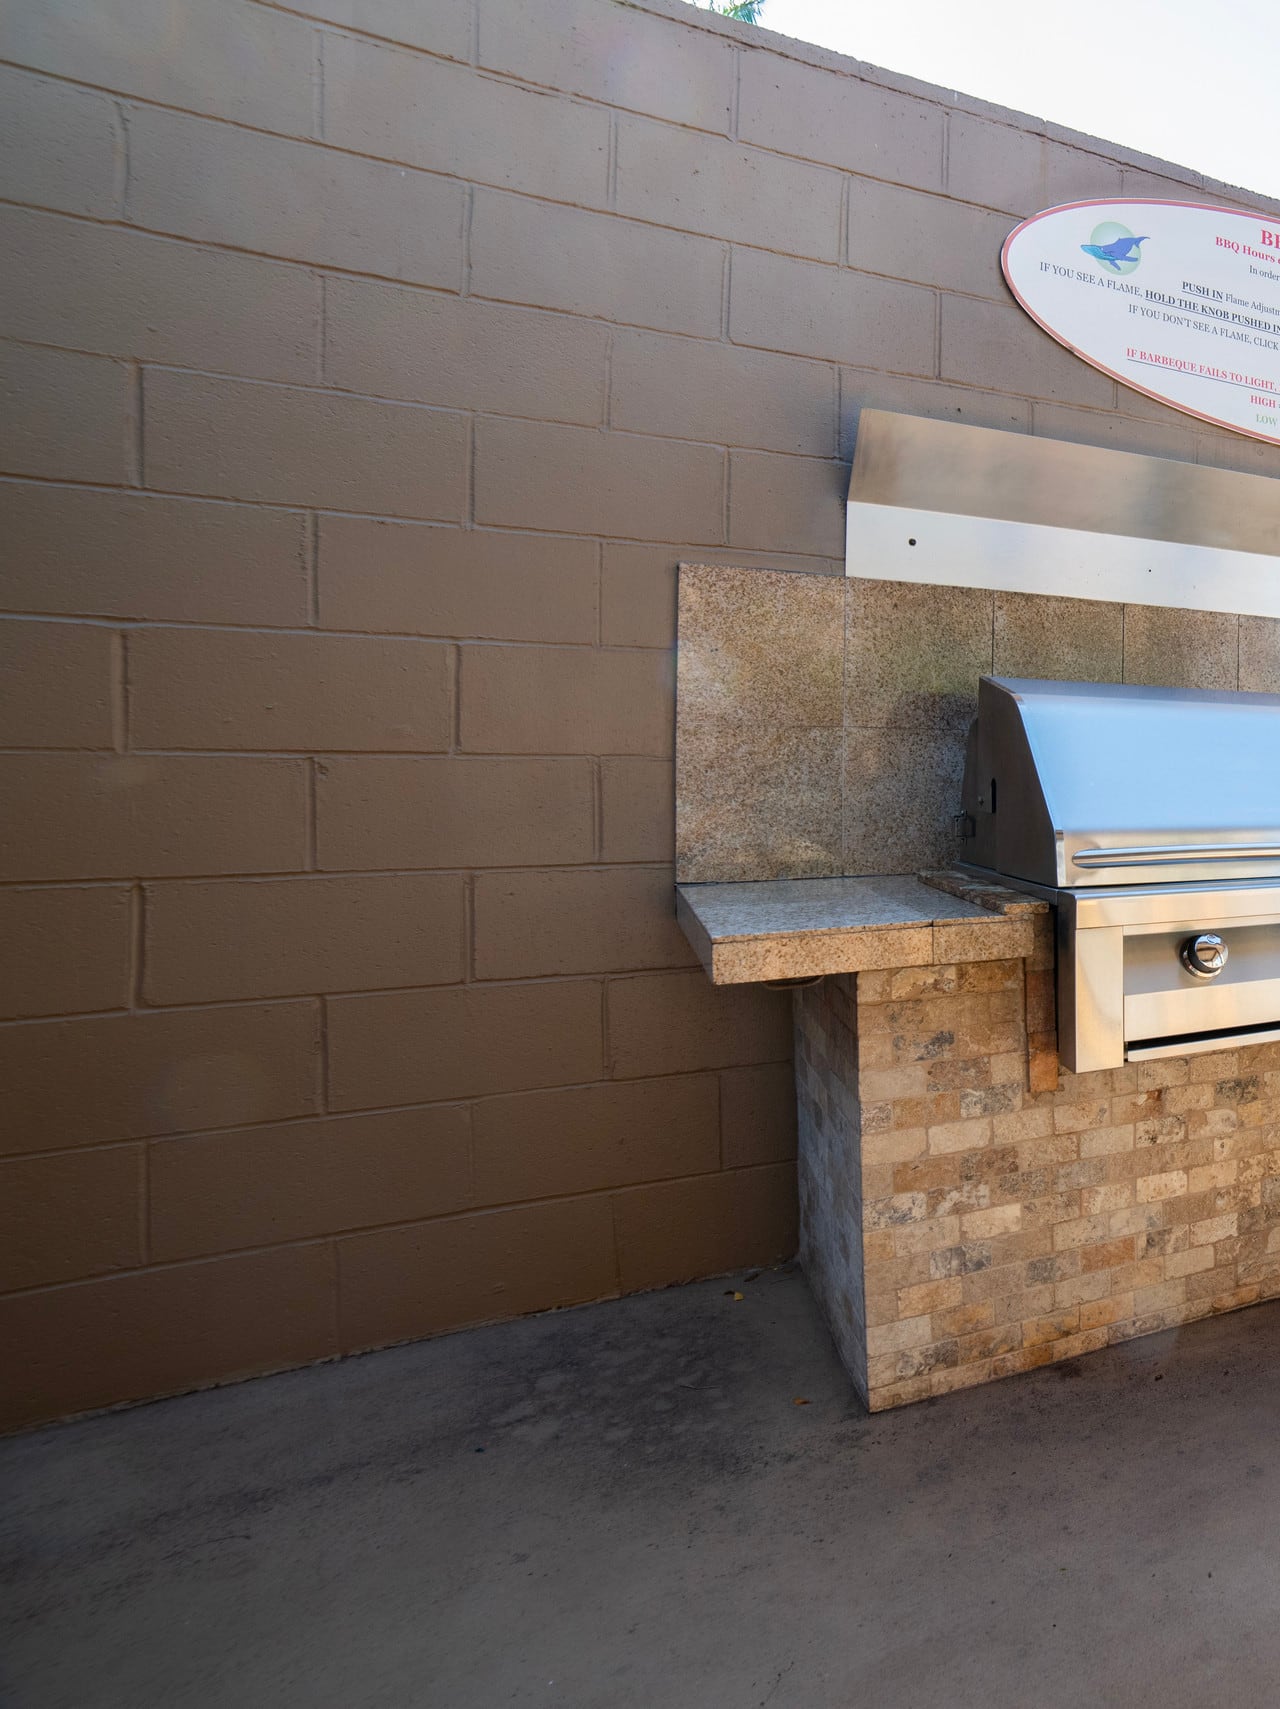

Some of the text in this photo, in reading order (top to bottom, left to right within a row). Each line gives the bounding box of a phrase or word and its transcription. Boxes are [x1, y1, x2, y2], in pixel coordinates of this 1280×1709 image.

[1216, 236, 1239, 253] BBQ
[1243, 244, 1275, 263] Hours
[1249, 265, 1258, 275] In
[1259, 268, 1280, 282] order
[1040, 261, 1050, 273] IF
[1053, 265, 1074, 279] YOU
[1076, 271, 1095, 284] SEE
[1098, 277, 1105, 287] A
[1145, 290, 1175, 305] HOLD
[1177, 298, 1199, 312] THE
[1201, 305, 1229, 320] KNOB
[1232, 313, 1270, 331] PUSHED
[1182, 282, 1211, 297] PUSH
[1212, 290, 1223, 300] IN
[1225, 294, 1249, 308] Flame
[1129, 304, 1138, 315] IF
[1140, 307, 1160, 320] YOU
[1193, 321, 1210, 333] SEE
[1211, 326, 1218, 335] A
[1253, 336, 1278, 351] CLICK
[1127, 348, 1137, 358] IF
[1140, 351, 1197, 372] BARBEQUE
[1200, 365, 1227, 380] FAILS
[1230, 372, 1242, 383] TO
[1250, 395, 1276, 408] HIGH
[1256, 414, 1278, 427] LOW
